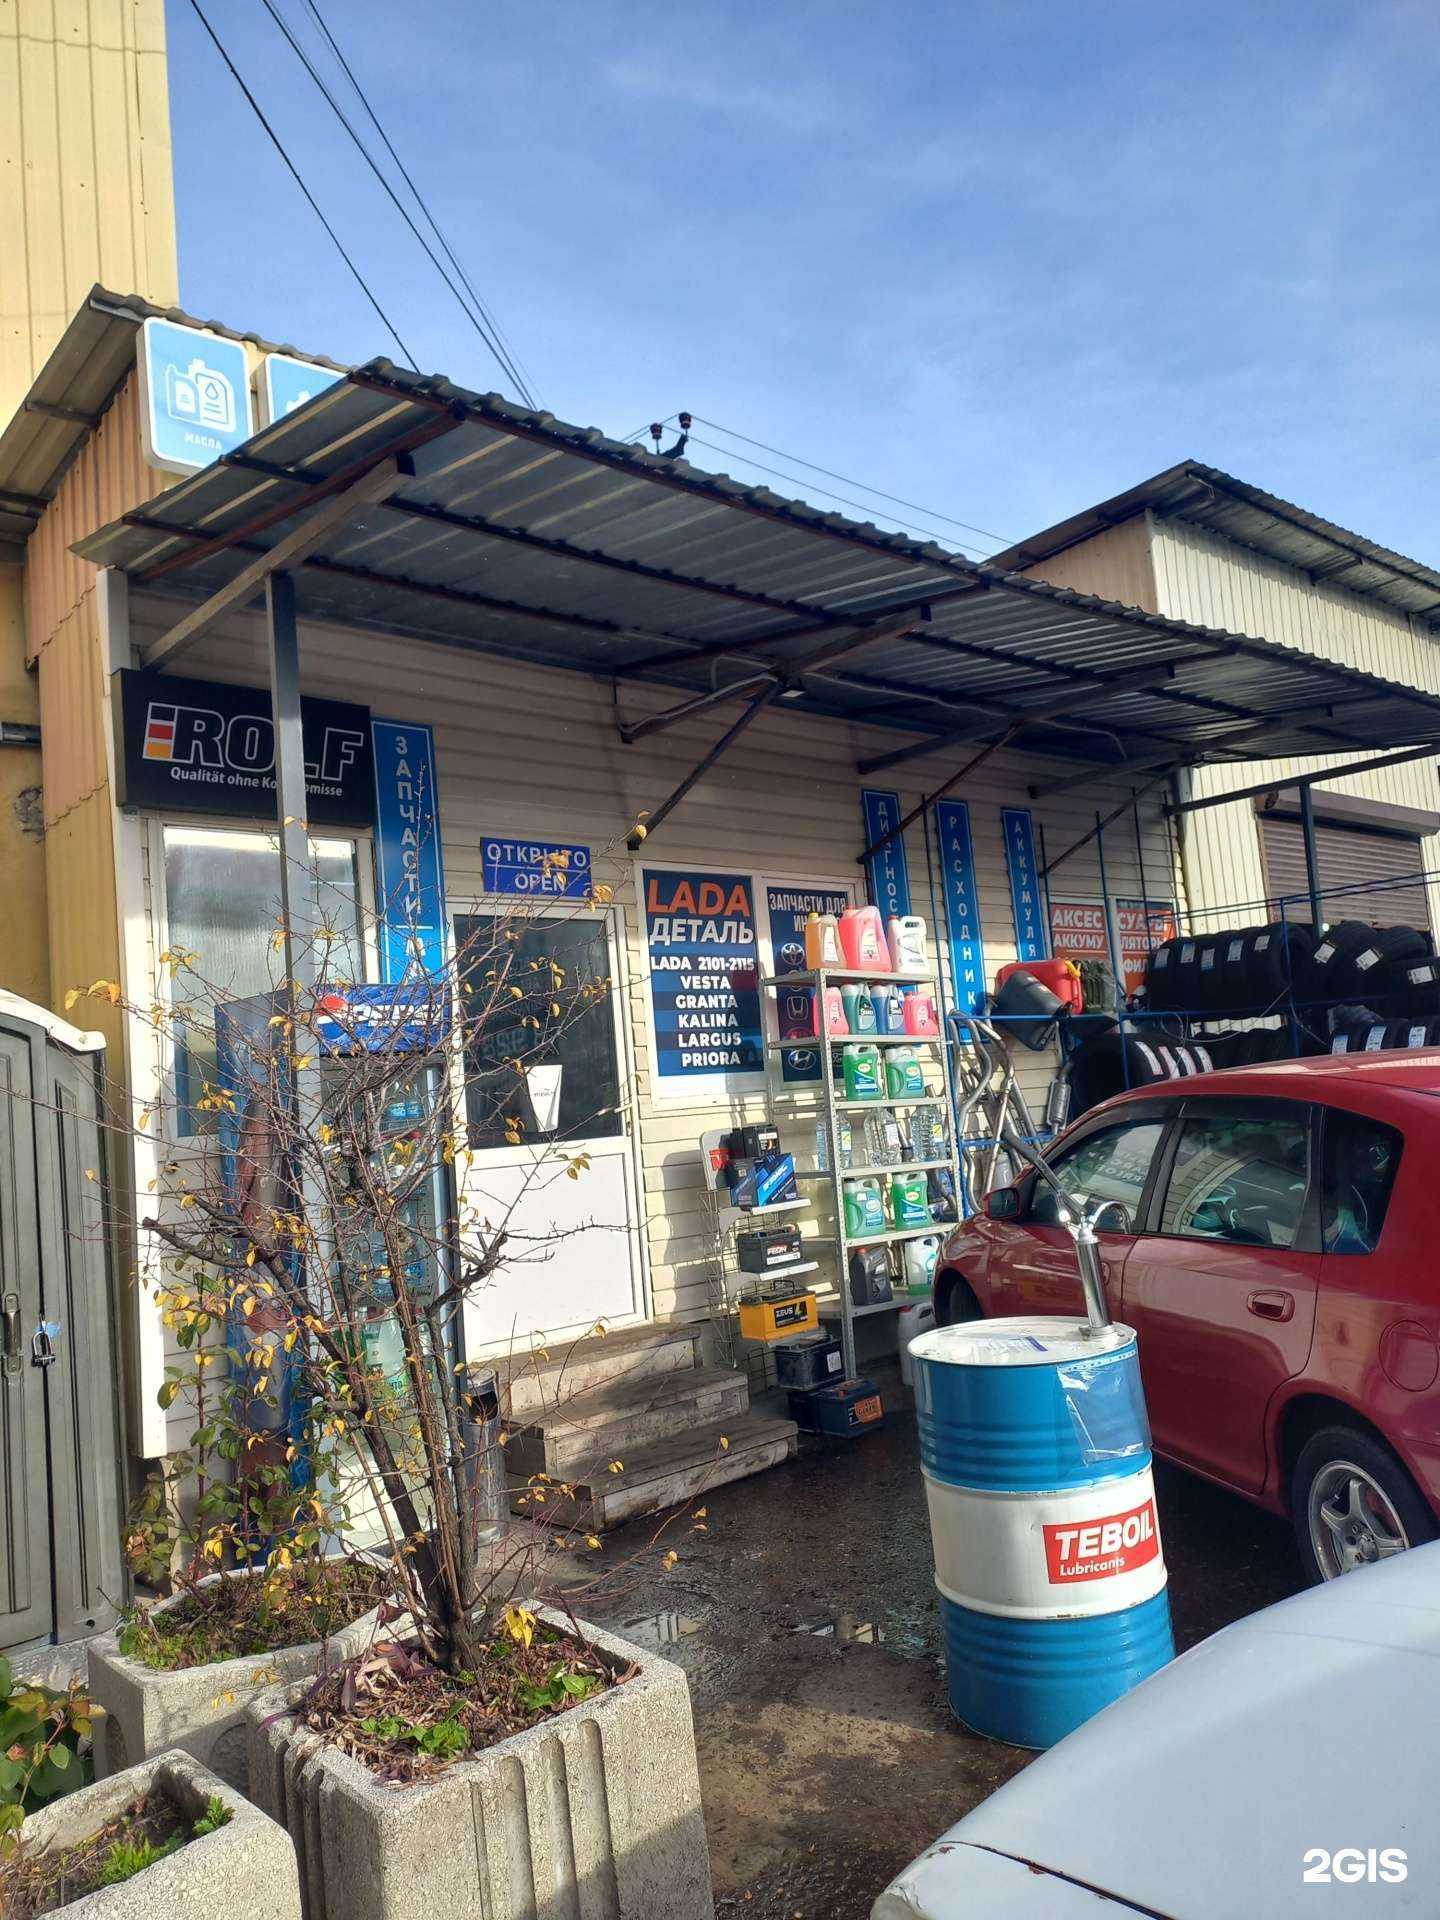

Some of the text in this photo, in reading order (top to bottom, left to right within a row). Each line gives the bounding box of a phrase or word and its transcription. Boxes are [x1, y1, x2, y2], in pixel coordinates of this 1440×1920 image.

[171, 706, 364, 781] ROF
[170, 767, 343, 797] Qualität ohne Koomisse
[514, 873, 566, 892] OPEN
[1014, 822, 1036, 958] АККУМУЛЯ
[647, 879, 750, 918] LADA
[769, 893, 824, 913] ЗАПЧАСТИ
[1052, 910, 1103, 928] АКСЕС
[650, 917, 754, 946] ДЕТАЛЬ
[1053, 933, 1104, 949] АККУМУ
[651, 956, 755, 971] LADA 2101-2115
[680, 975, 731, 990] VESTA
[675, 994, 738, 1010] GRANTA
[678, 1013, 738, 1029] KALINA
[678, 1032, 743, 1048] LARGUS
[682, 1051, 741, 1068] PRIORA
[1055, 1509, 1154, 1561] TEBOIL
[1060, 1556, 1126, 1577] Lubricants
